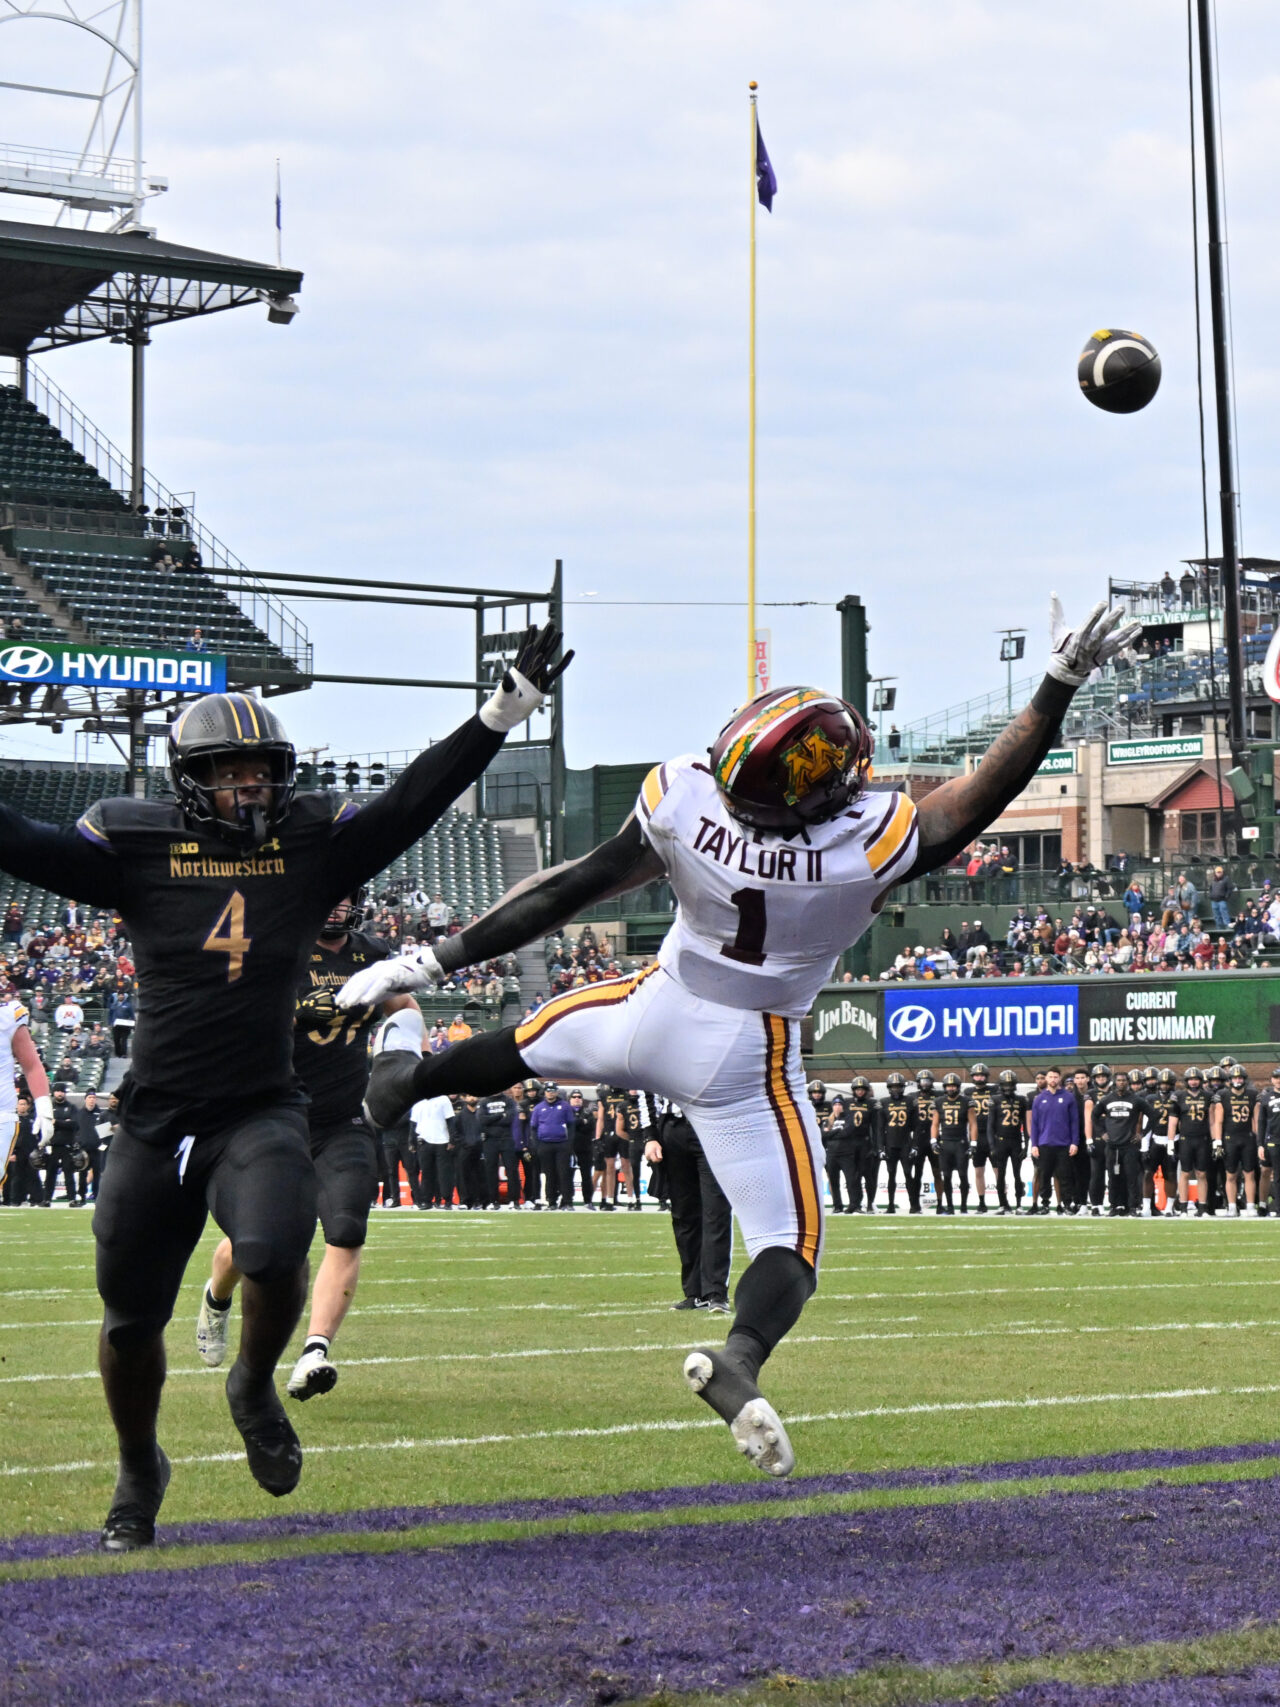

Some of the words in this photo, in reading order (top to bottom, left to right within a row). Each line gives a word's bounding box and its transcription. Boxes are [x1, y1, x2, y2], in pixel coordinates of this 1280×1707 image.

[61, 652, 212, 687] HYUNDAI
[1111, 742, 1201, 759] WRIGLEYROOFTOPS.COM
[693, 816, 796, 882] TAYLOR
[807, 849, 823, 882] II
[170, 855, 285, 878] Northwestern
[201, 889, 252, 984] 4
[720, 887, 767, 967] 1
[1126, 990, 1178, 1010] CURRENT
[814, 1005, 842, 1041] JIM
[842, 1000, 877, 1040] BEAM
[942, 1004, 1074, 1038] HYUNDAI
[1089, 1016, 1132, 1042] DRIVE
[1133, 1013, 1216, 1041] SUMMARY
[888, 1110, 907, 1127] 29
[945, 1109, 959, 1126] 51
[1188, 1104, 1205, 1121] 45
[1231, 1105, 1250, 1122] 59
